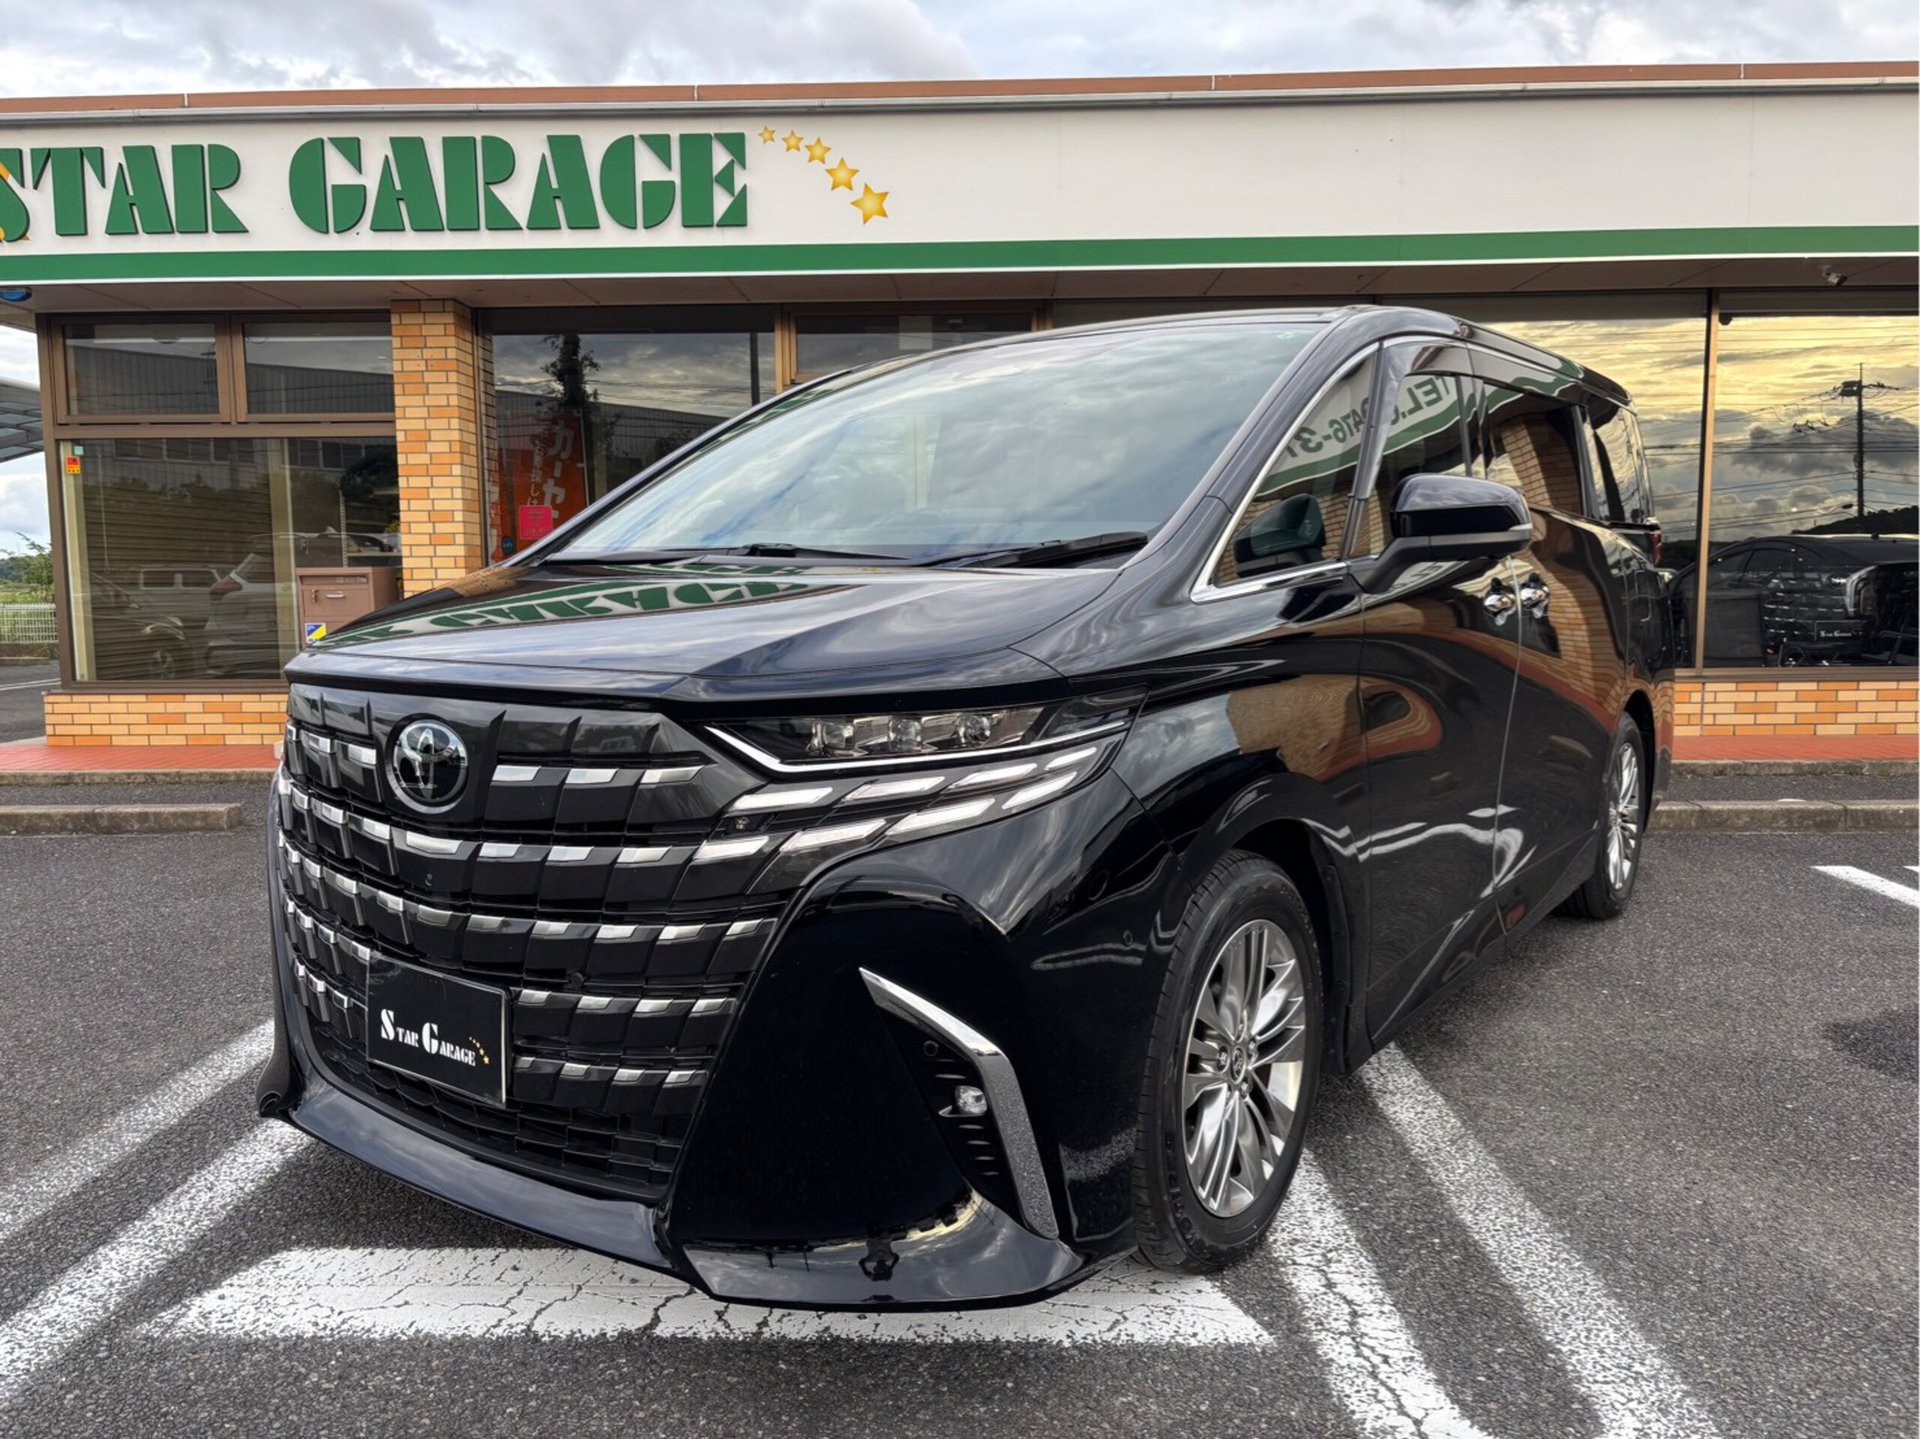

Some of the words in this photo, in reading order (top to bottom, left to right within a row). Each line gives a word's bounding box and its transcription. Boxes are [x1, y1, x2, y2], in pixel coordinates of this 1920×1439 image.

[289, 132, 747, 233] GARAGE
[380, 1008, 419, 1048] STAR
[421, 1021, 476, 1067] GARAGE
